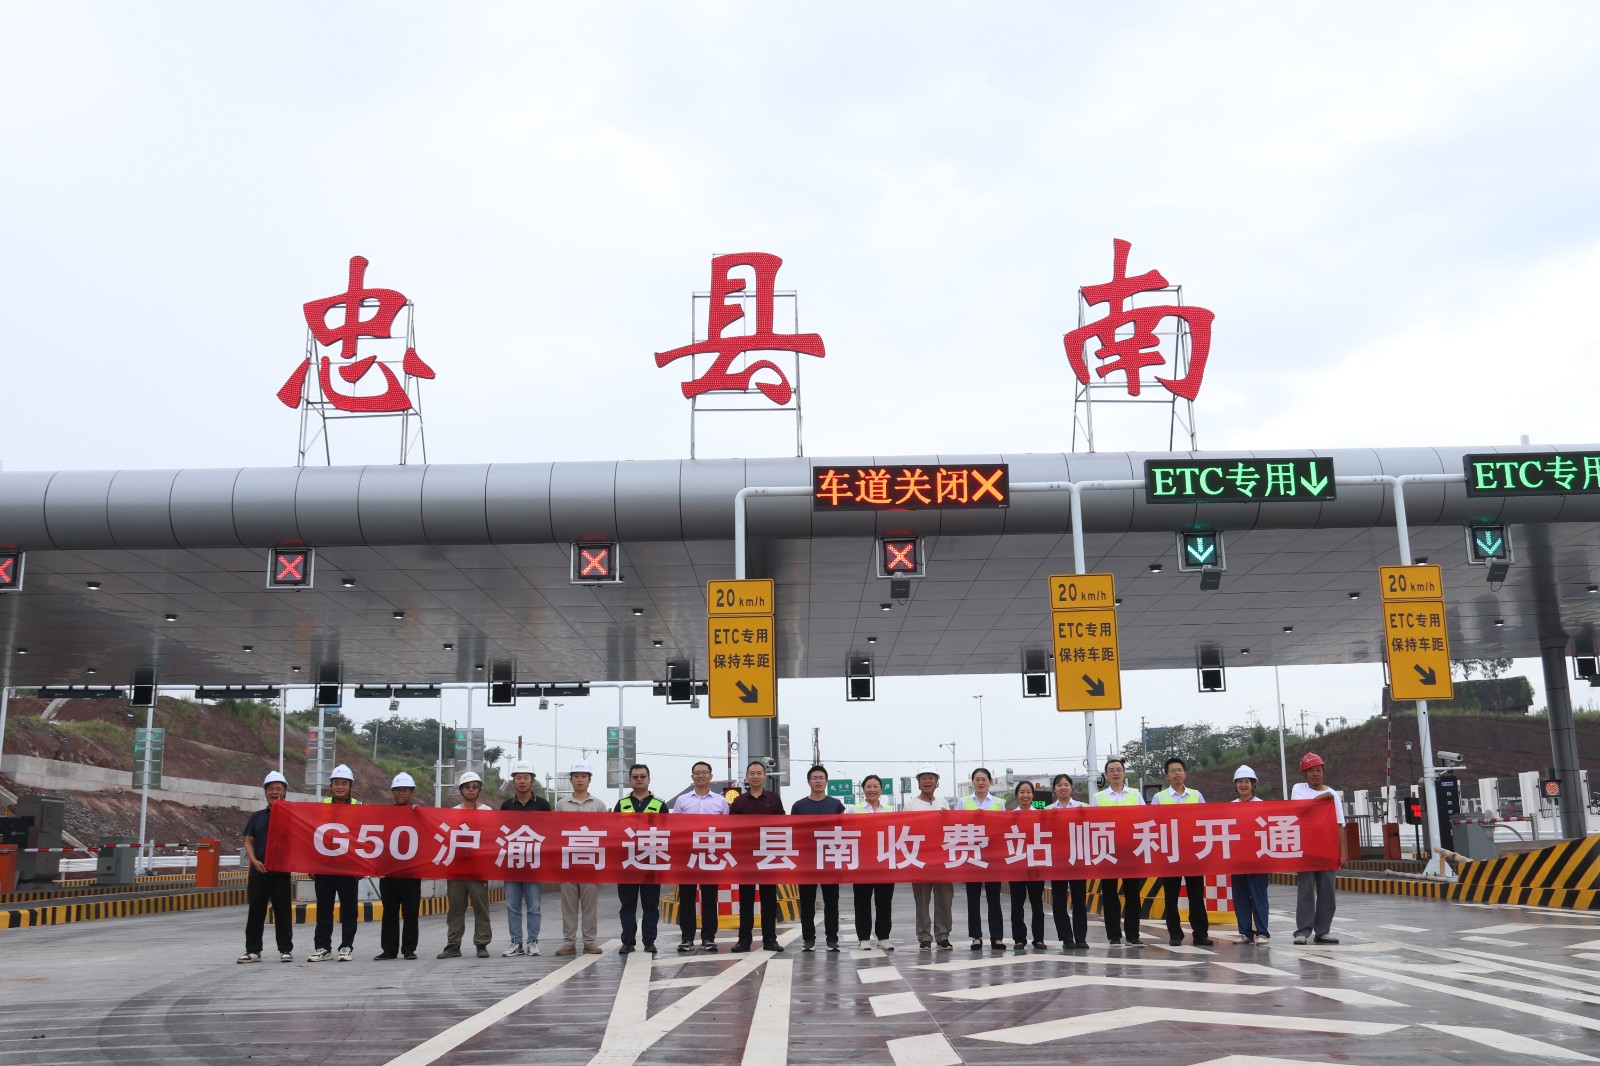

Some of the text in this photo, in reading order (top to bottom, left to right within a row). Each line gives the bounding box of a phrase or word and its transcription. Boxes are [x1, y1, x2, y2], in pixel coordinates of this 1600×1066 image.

[1152, 461, 1297, 498] ETC专用
[1388, 574, 1435, 593] 20 km/h
[715, 588, 765, 607] 20 km/h
[1058, 583, 1107, 602] 20 km/h
[1389, 613, 1442, 629] ETC专用
[714, 628, 768, 644] ETC专用
[1058, 622, 1112, 638] ETC专用
[1390, 637, 1446, 653] 保持车距
[713, 653, 770, 669] 保持车距
[1058, 647, 1114, 663] 保持车距
